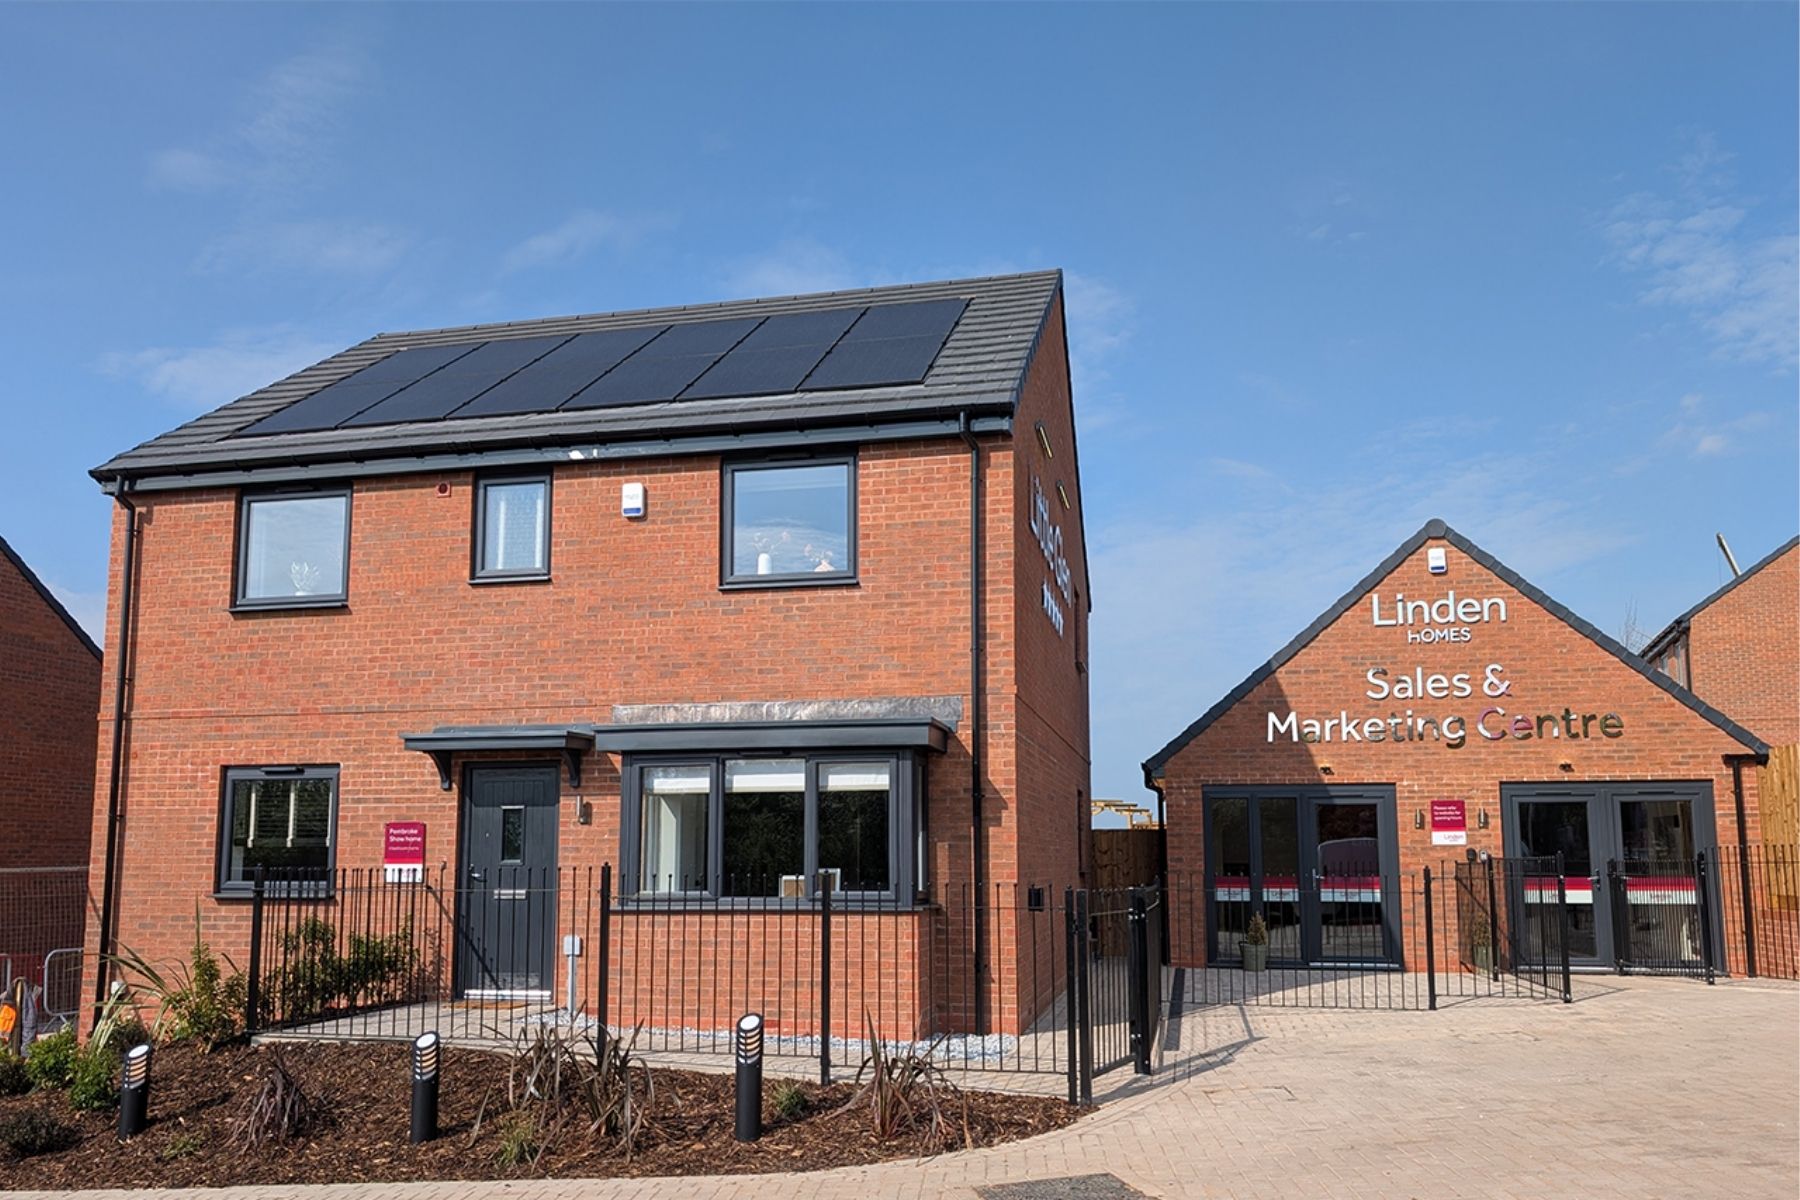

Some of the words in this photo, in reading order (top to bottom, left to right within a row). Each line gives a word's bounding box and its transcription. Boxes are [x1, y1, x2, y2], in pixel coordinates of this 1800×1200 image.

[1371, 591, 1507, 627] Linden
[1407, 627, 1472, 644] HOMES
[1366, 667, 1473, 700] Sales
[1483, 663, 1512, 697] &
[1266, 709, 1467, 749] Marketing
[1476, 707, 1625, 741] Centre
